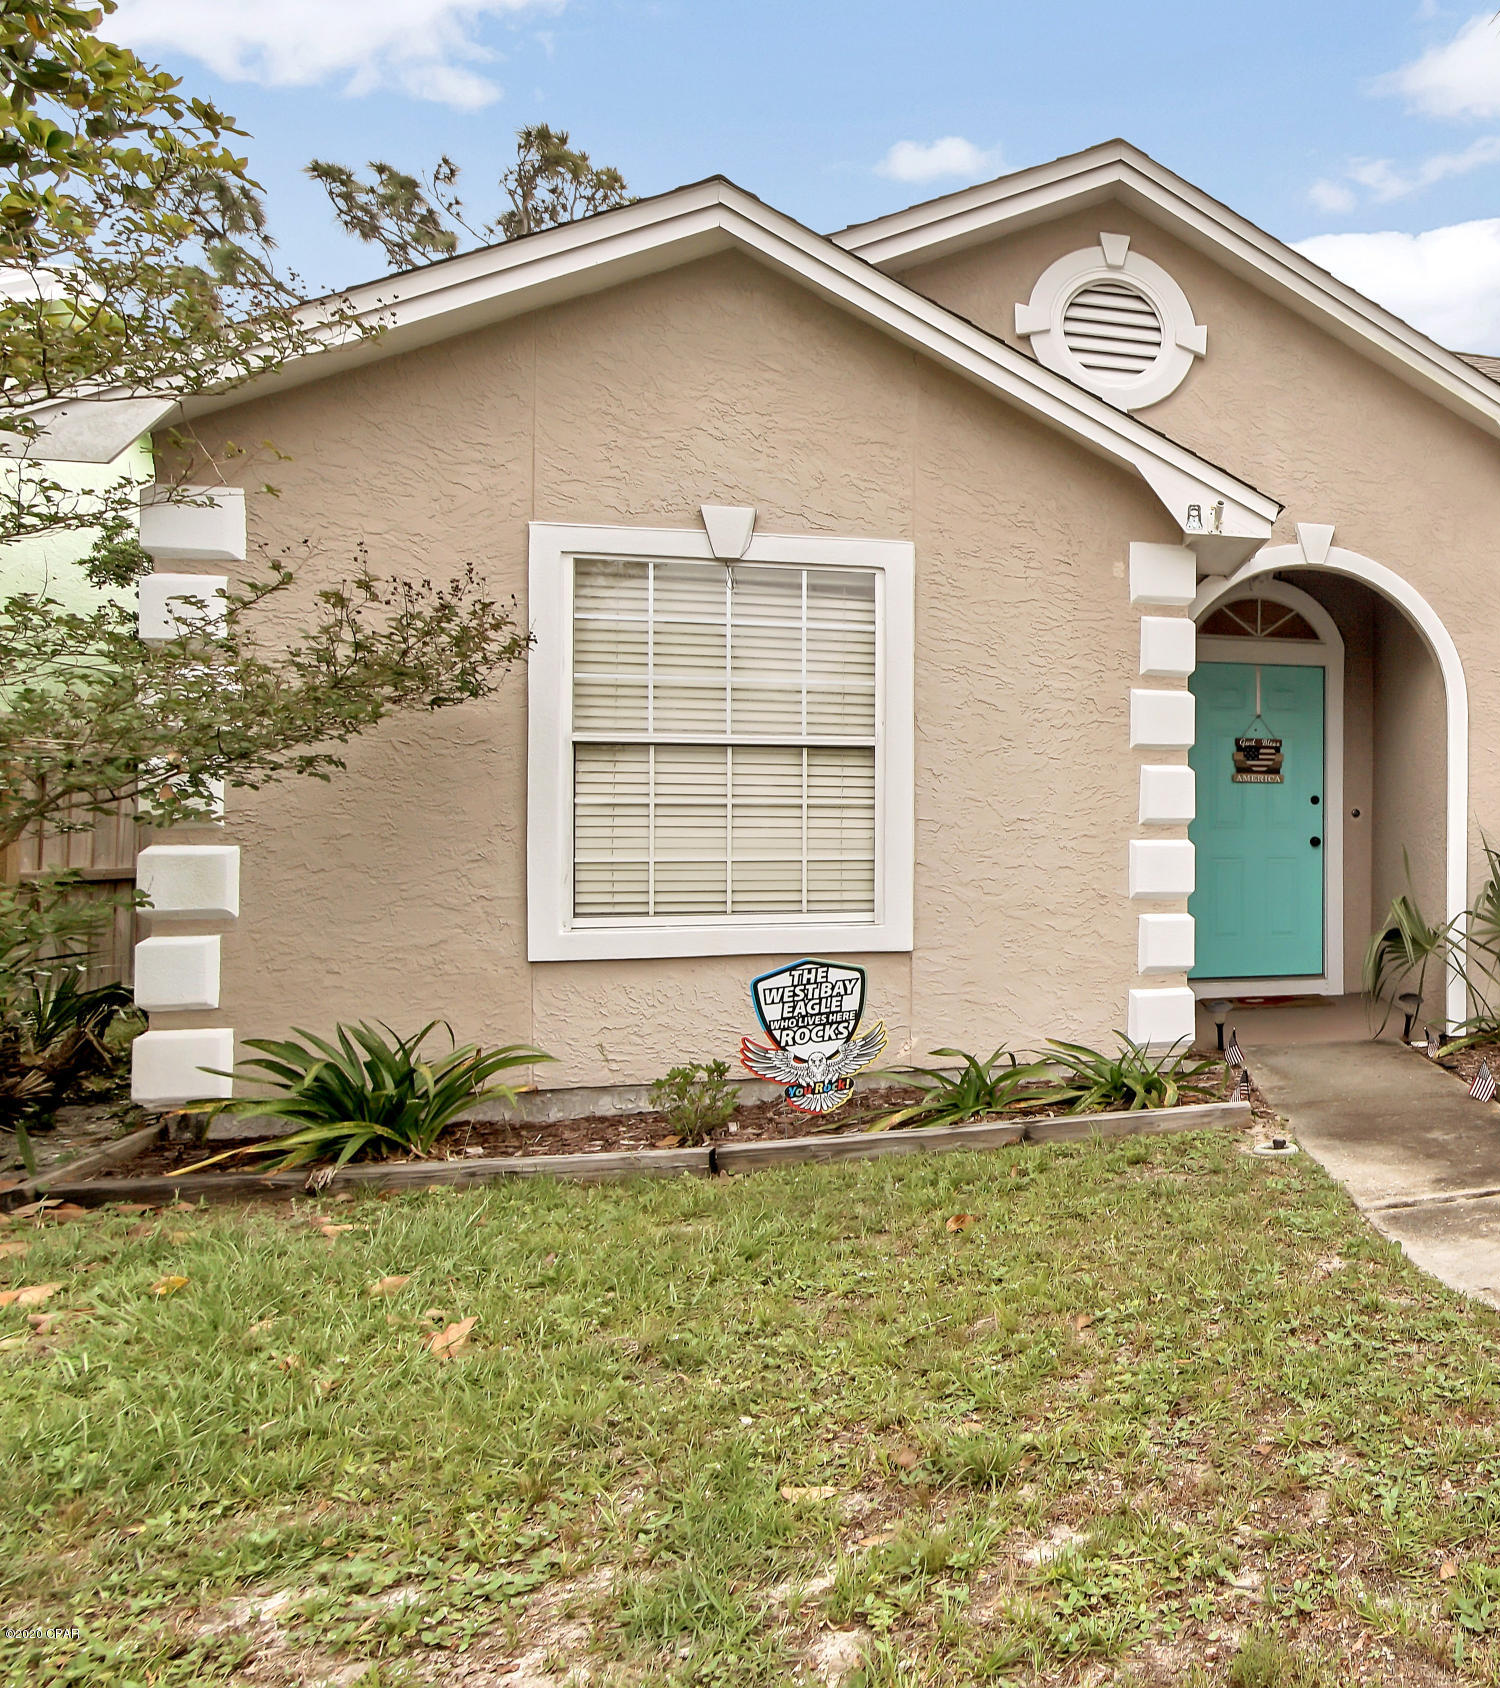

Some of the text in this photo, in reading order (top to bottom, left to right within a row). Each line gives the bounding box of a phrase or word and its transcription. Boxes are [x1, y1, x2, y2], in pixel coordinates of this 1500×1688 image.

[1236, 775, 1281, 783] AMERICA
[791, 967, 828, 985] THE
[782, 996, 842, 1018] EAGLE
[770, 1011, 856, 1030] WHO LIVES HERE
[781, 1023, 848, 1047] ROCKS
